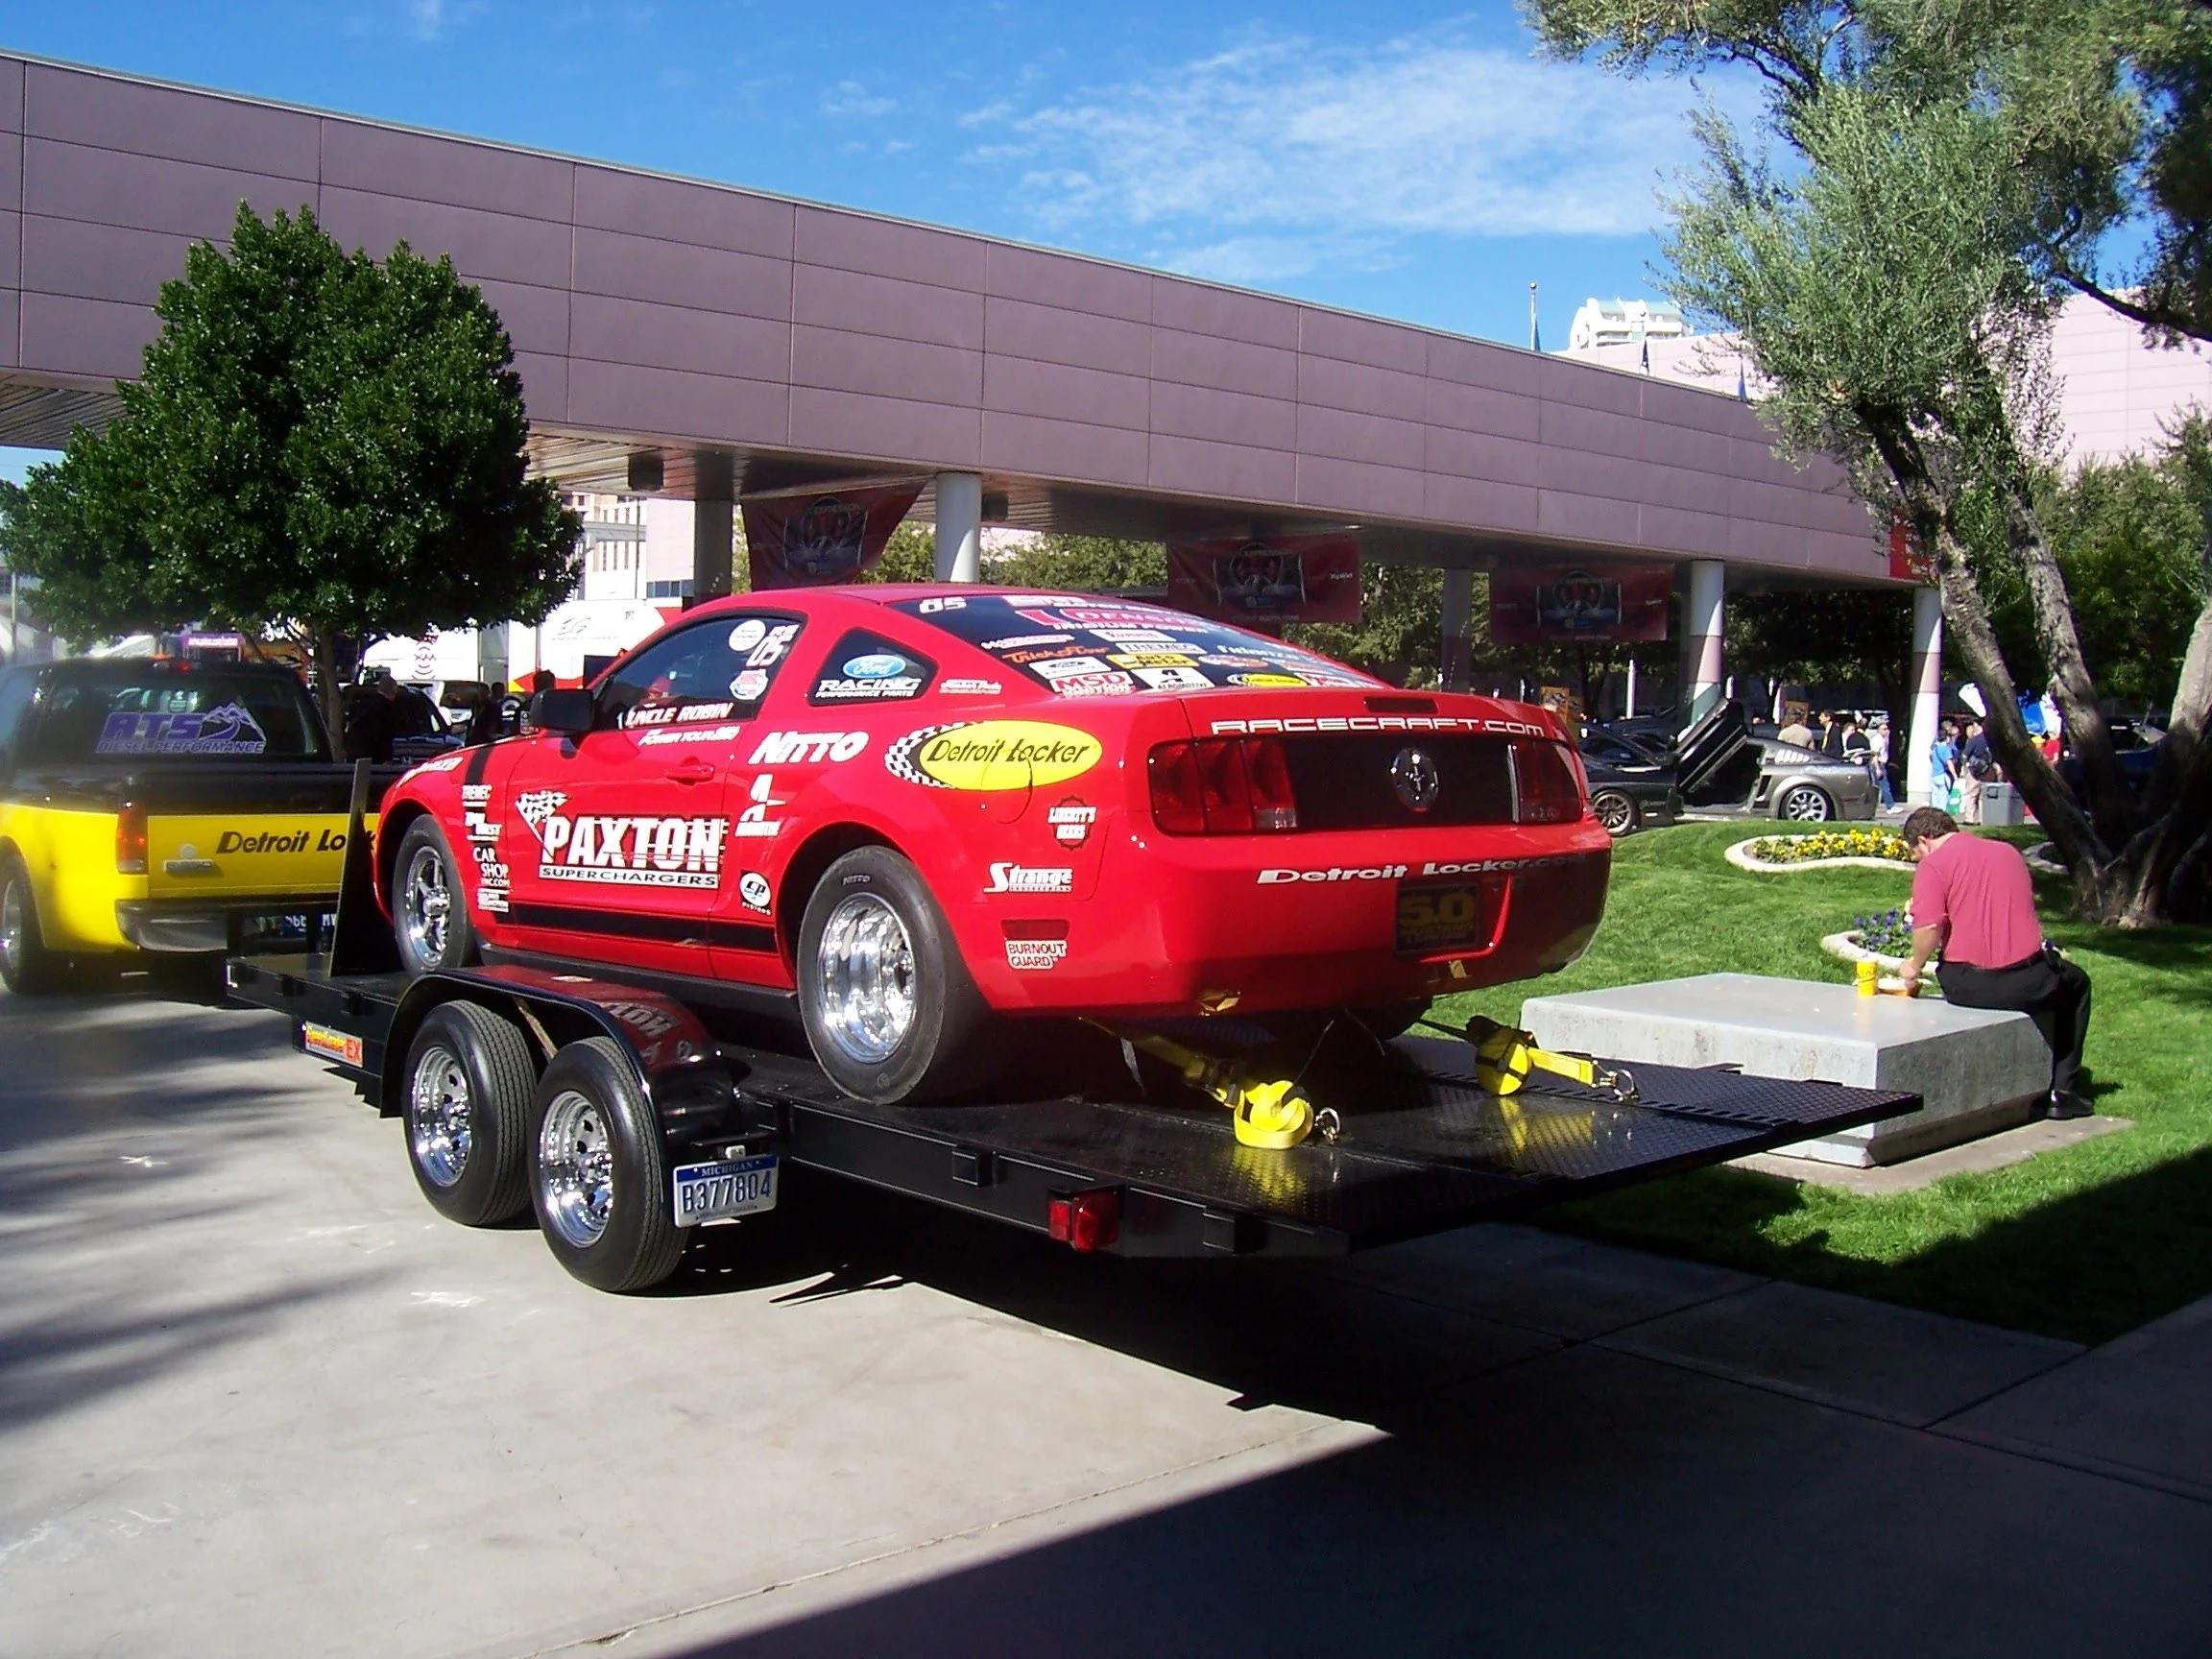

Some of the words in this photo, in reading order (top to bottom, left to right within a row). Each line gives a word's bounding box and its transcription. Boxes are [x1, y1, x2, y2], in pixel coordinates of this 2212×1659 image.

[818, 678, 923, 691] RACING
[1056, 673, 1126, 689] MSD
[100, 711, 206, 740] ATS
[153, 739, 267, 754] PERFORMANCE
[748, 731, 870, 764] NITTO
[926, 738, 1004, 763] Detroit
[1004, 738, 1090, 764] Locker
[216, 830, 309, 854] Detroit
[541, 815, 727, 872] PAXTON
[472, 847, 497, 863] CAR
[481, 862, 510, 878] SHOP
[542, 867, 717, 886] SUPERCHARGERS
[1257, 864, 1408, 885] Detroit
[1007, 943, 1066, 956] BURNOUT
[1011, 955, 1053, 968] GUARD
[701, 1162, 754, 1177] MICHIGAN
[682, 1169, 772, 1214] B377804
